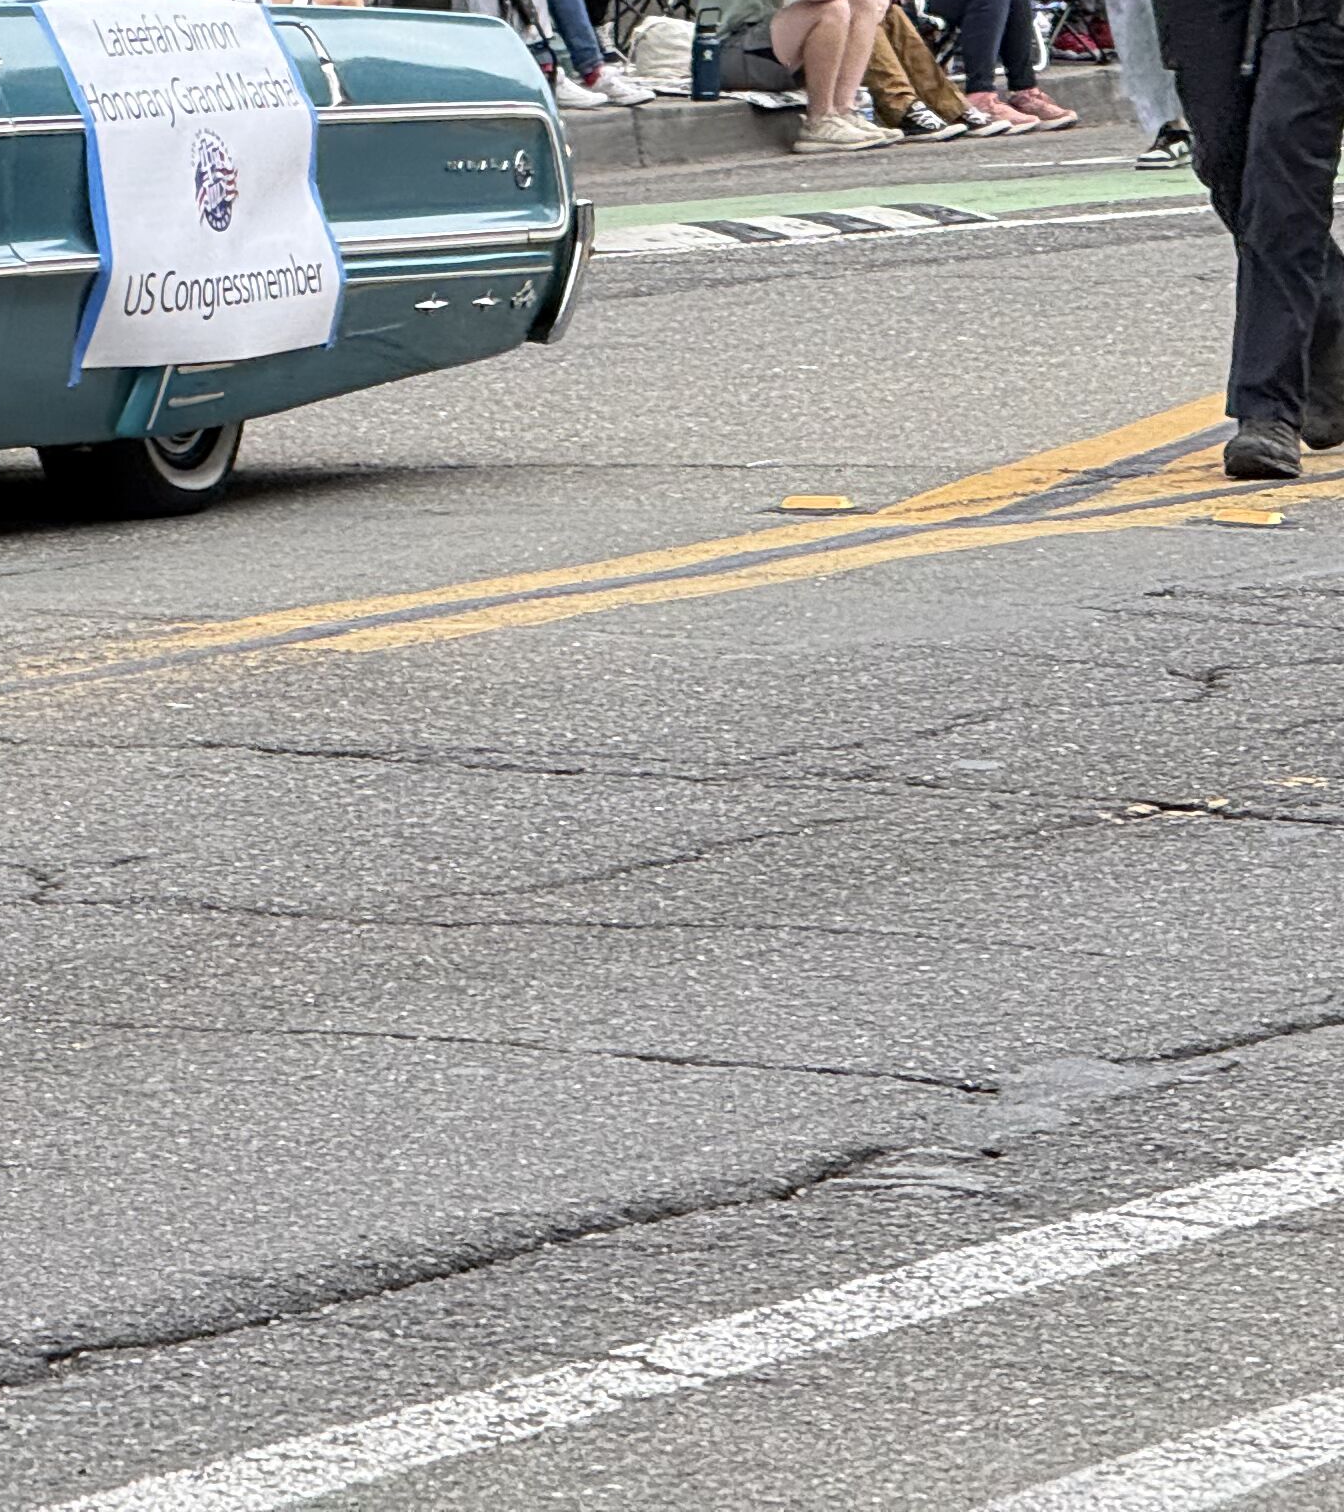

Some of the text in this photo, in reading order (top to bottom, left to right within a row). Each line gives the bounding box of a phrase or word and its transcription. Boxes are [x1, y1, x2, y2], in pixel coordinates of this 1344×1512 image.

[92, 14, 241, 57] Lateefah Simon
[80, 83, 175, 128] Honorary
[170, 71, 232, 115] Grand
[123, 253, 323, 320] US Congressmember
